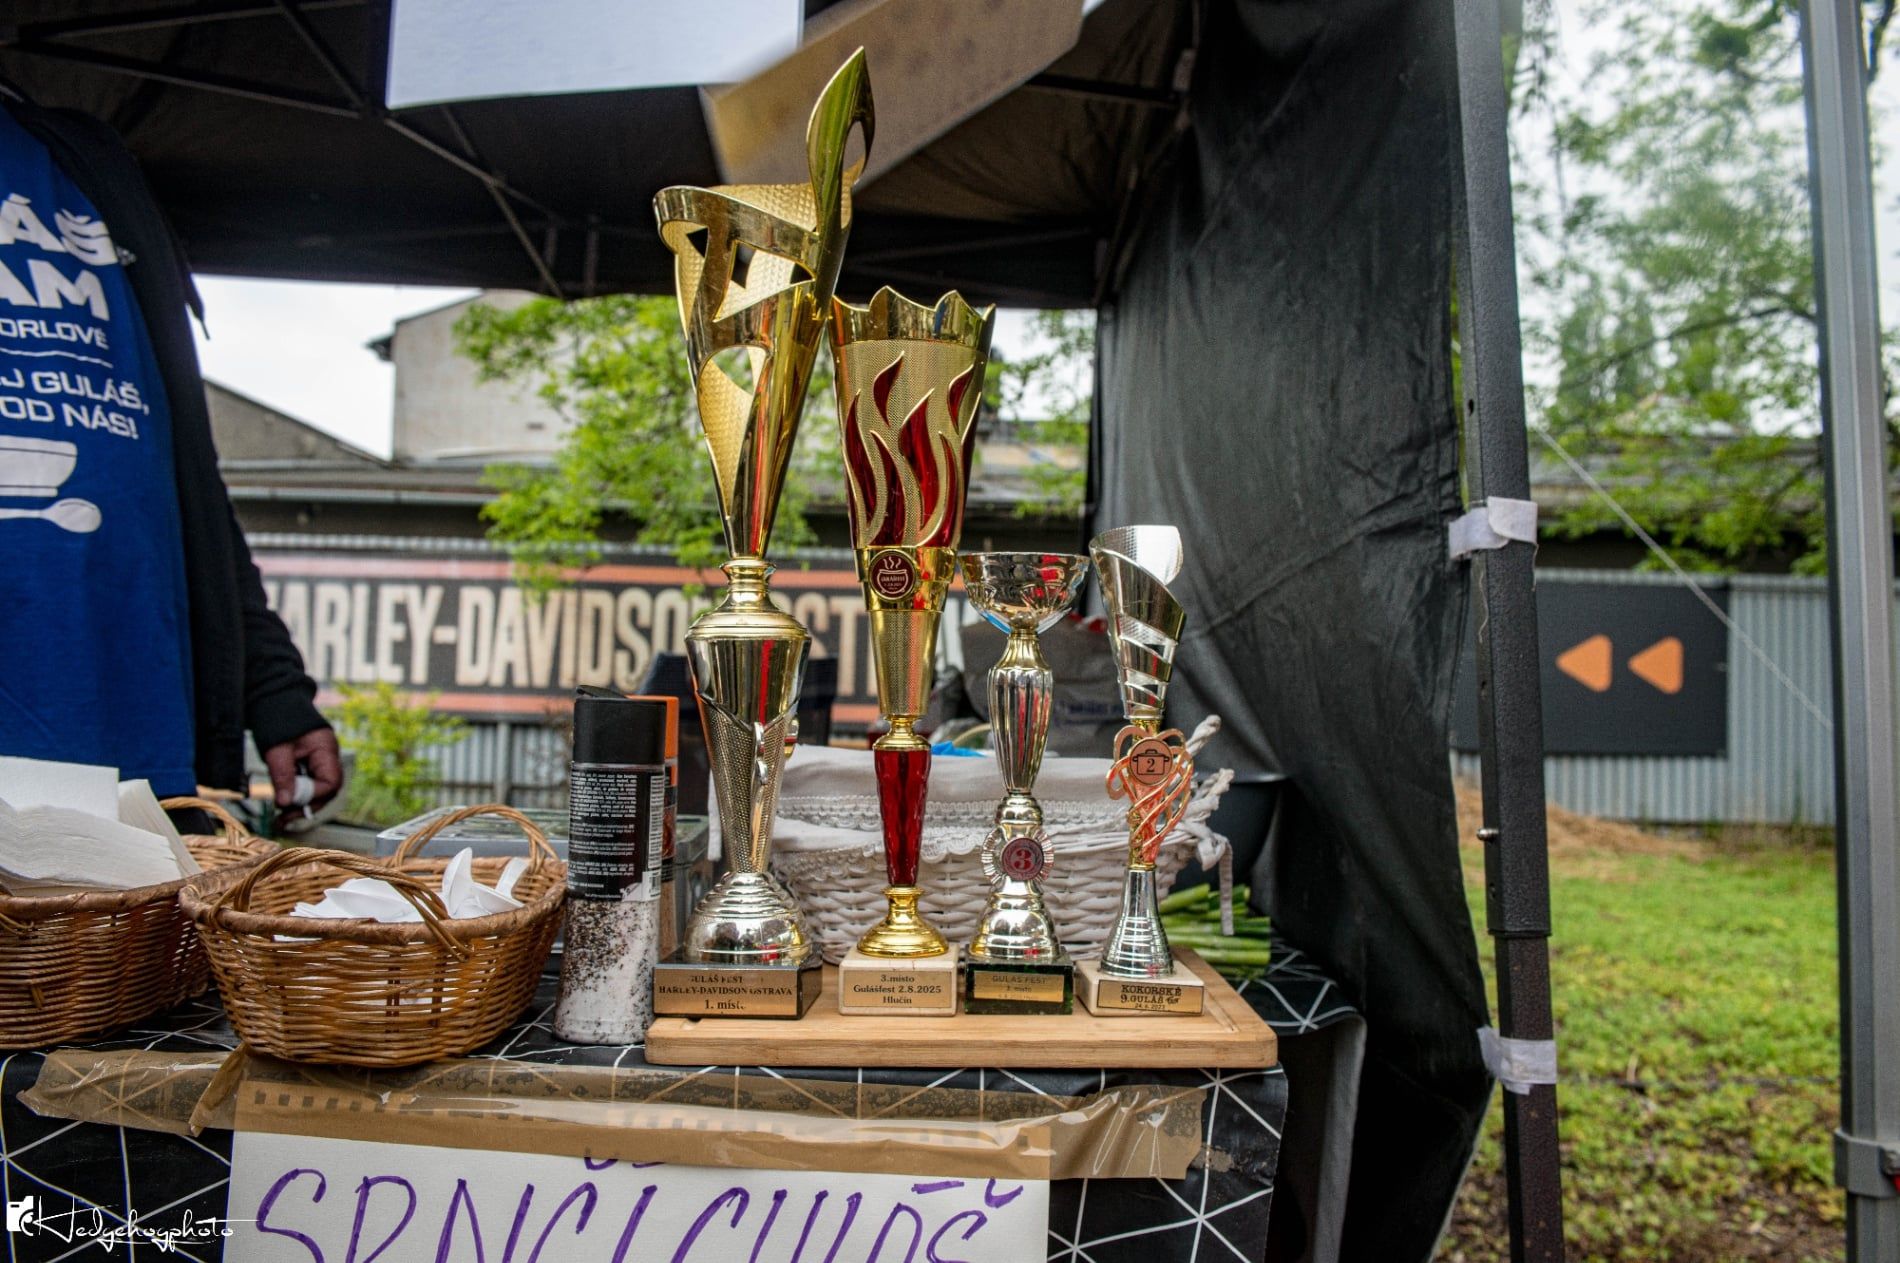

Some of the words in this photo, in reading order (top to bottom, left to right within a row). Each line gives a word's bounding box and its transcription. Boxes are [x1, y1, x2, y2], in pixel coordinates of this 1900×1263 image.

[62, 402, 139, 440] NÁS!
[264, 580, 716, 693] ARLEY-DAVIDSO
[1146, 757, 1156, 773] 2
[1014, 850, 1032, 869] 3
[659, 986, 746, 995] HARLEY-DAVIDSON
[853, 984, 895, 993] Gulášfest
[898, 985, 942, 994] 2.8.2025
[704, 1000, 714, 1010] 1.
